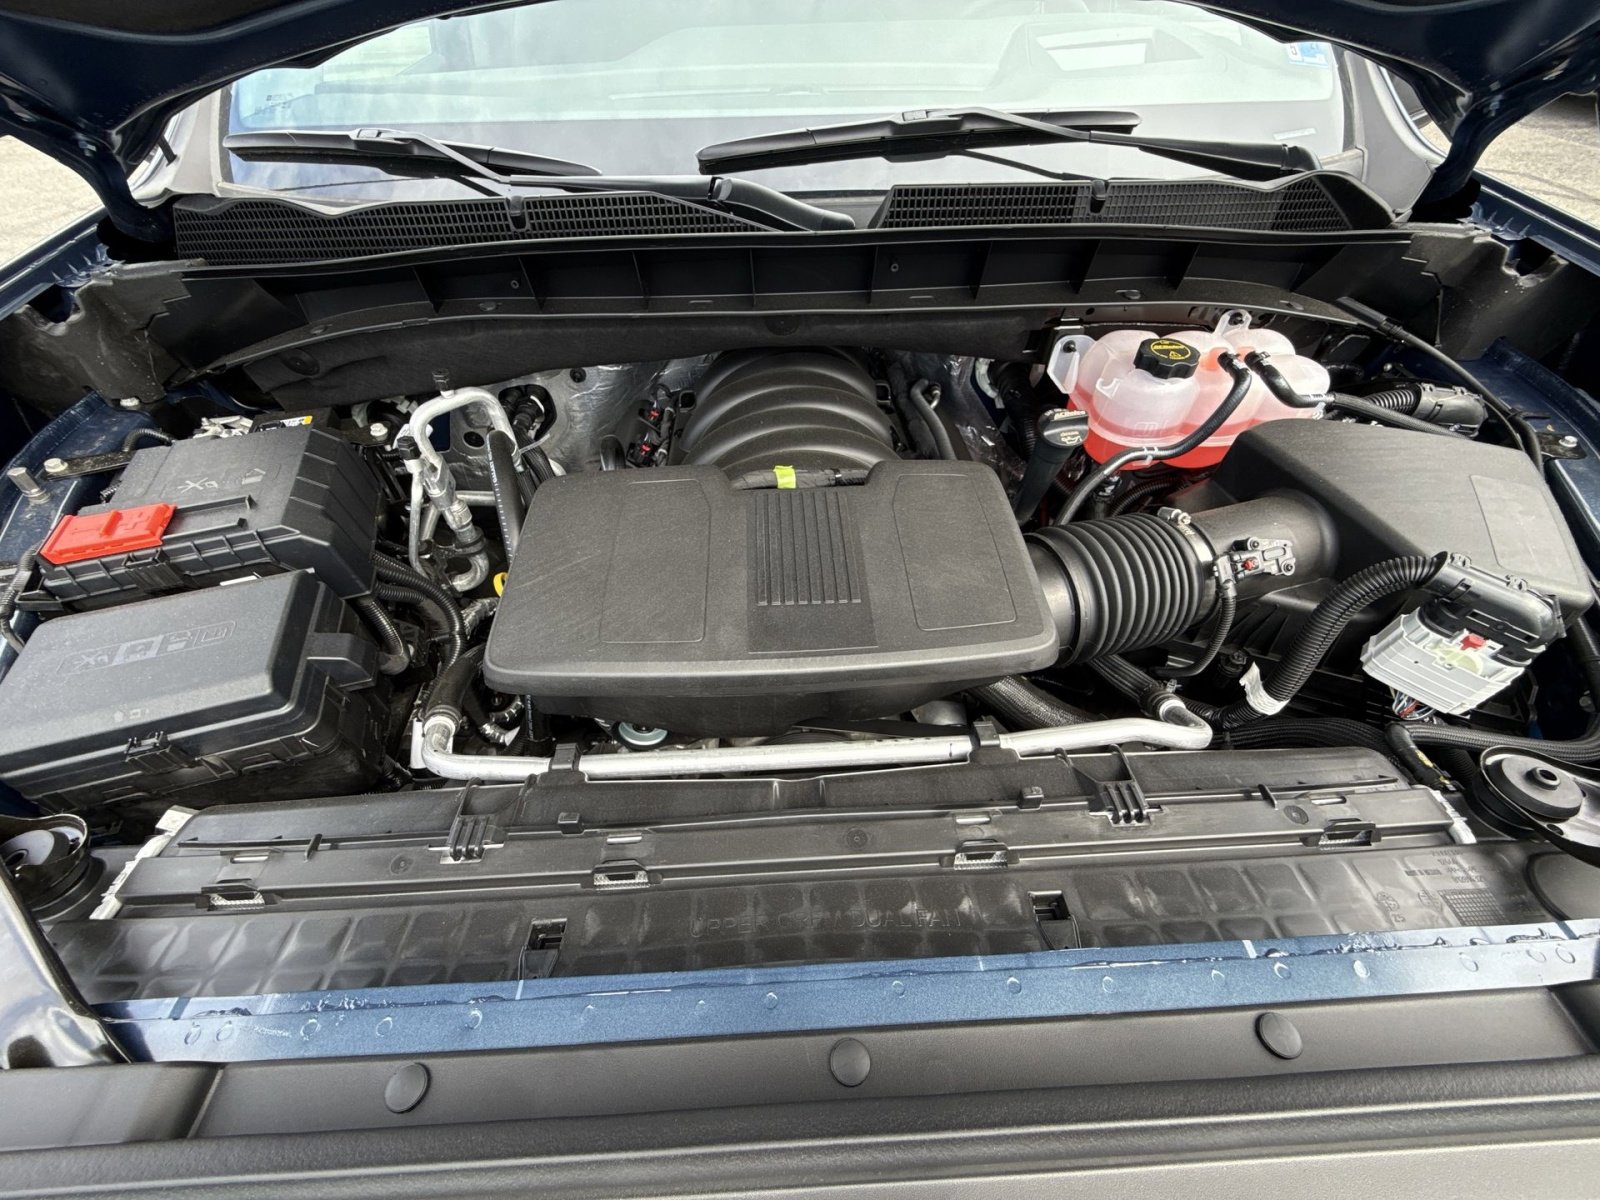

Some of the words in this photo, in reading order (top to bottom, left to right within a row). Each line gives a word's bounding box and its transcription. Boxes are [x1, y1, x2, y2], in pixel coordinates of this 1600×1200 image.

[690, 911, 769, 938] UPPER
[851, 907, 912, 928] DUAL
[915, 906, 962, 928] FAN
